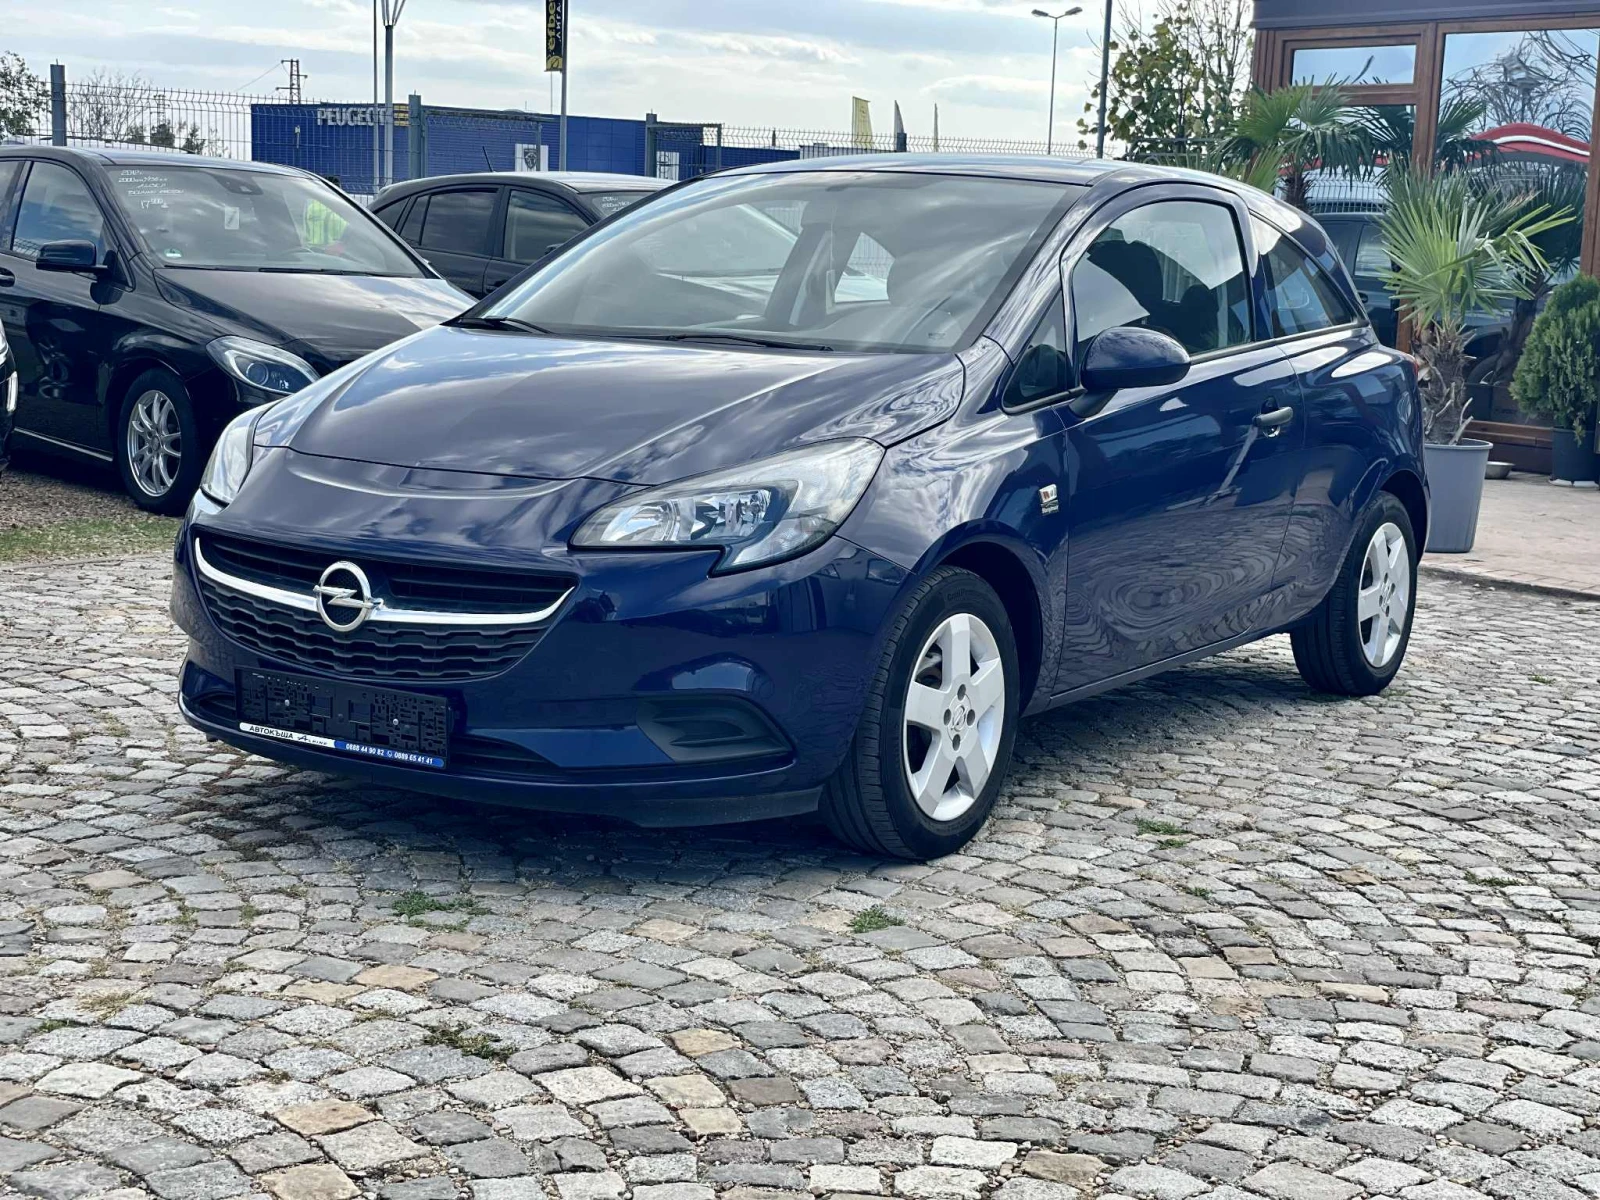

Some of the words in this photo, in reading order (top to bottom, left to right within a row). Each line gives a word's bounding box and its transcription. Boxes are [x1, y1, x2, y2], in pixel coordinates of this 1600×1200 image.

[547, 0, 556, 51] efbe
[316, 107, 386, 126] PEUGEOT
[249, 725, 293, 739] АВТОКЪША
[346, 743, 360, 752] 0888
[426, 757, 433, 765] 41
